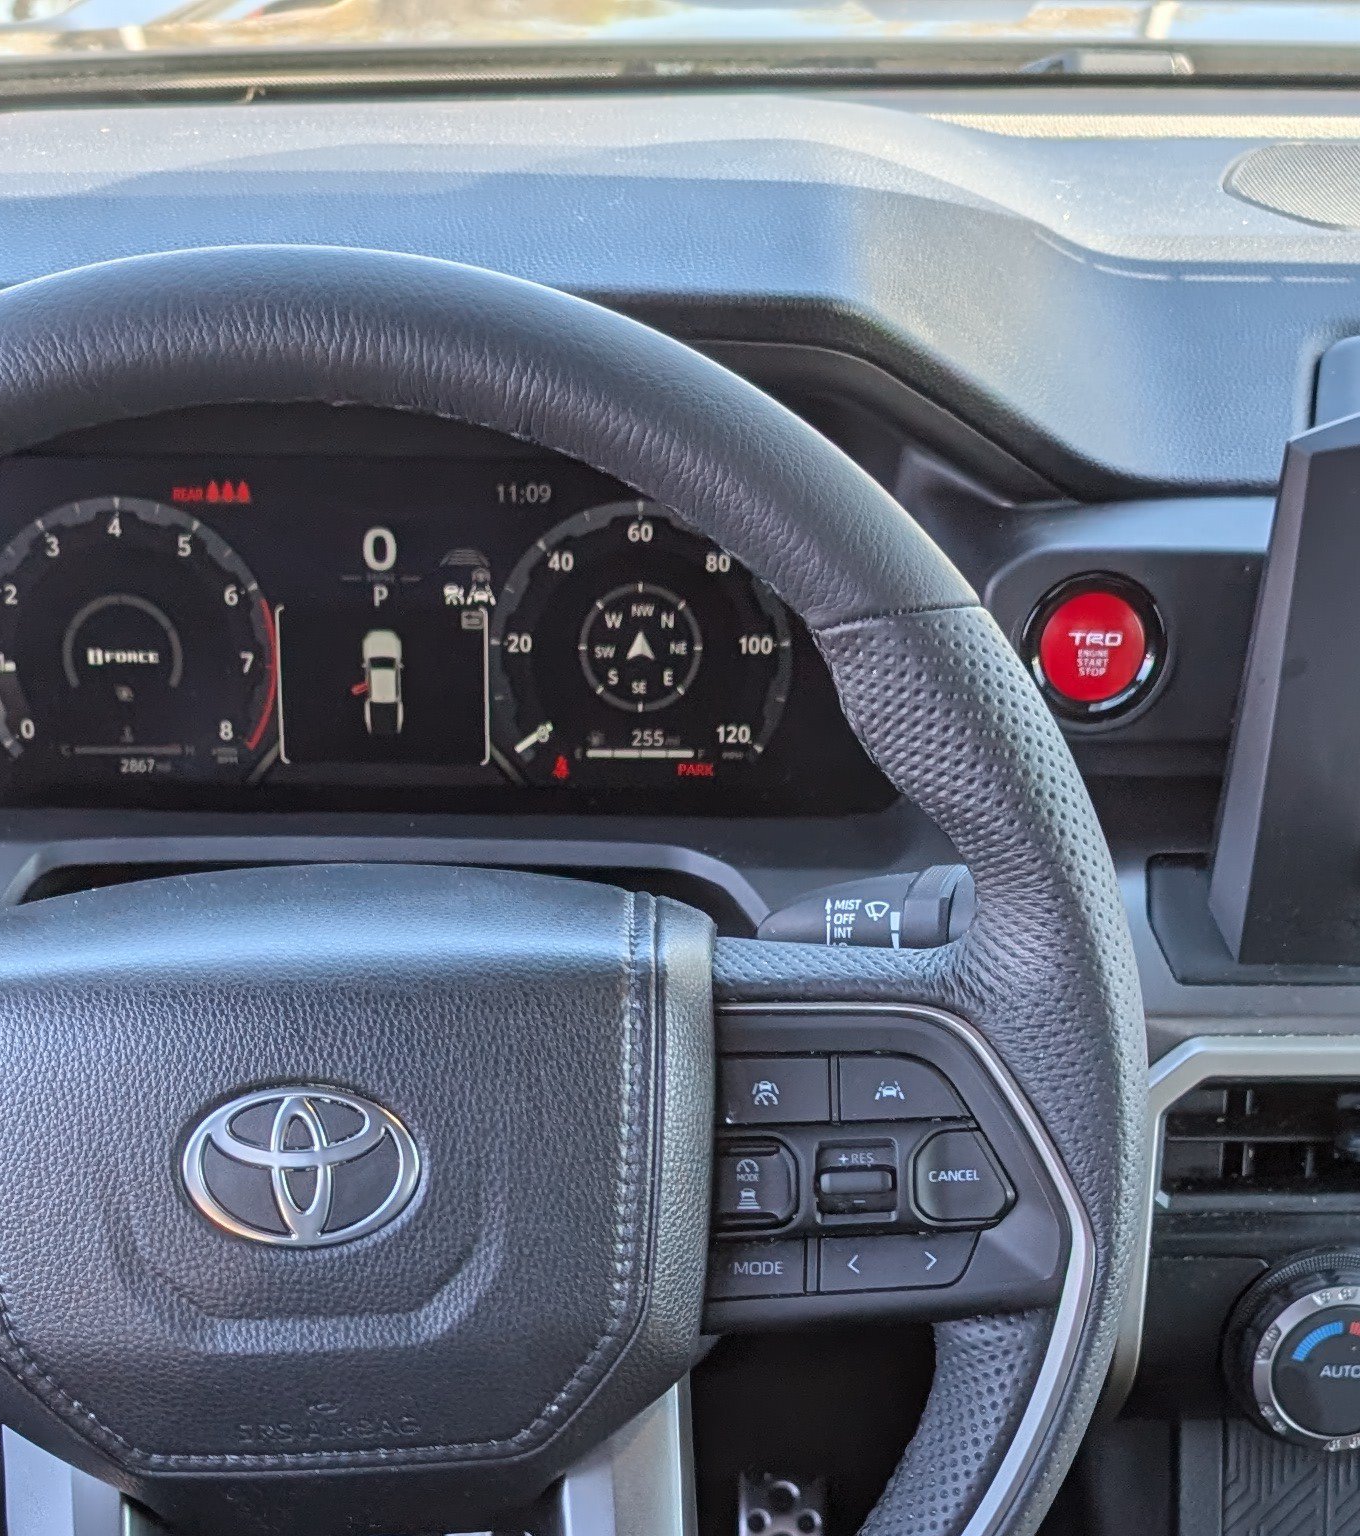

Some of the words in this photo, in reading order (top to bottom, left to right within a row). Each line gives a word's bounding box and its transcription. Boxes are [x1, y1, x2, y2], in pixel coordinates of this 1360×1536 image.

[496, 483, 551, 503] 11:09
[107, 518, 122, 537] 4
[626, 521, 654, 542] 60
[45, 536, 60, 557] 3
[177, 536, 191, 557] 5
[362, 526, 397, 571] 0
[547, 552, 574, 572] 40
[705, 553, 731, 573] 80
[2, 583, 18, 605] 2
[223, 584, 239, 606] 6
[372, 583, 389, 607] P
[604, 612, 623, 629] W
[660, 612, 675, 629] N
[507, 634, 533, 653] 20
[739, 635, 773, 655] 100
[1068, 631, 1123, 646] TRD
[240, 651, 254, 673] 7
[607, 668, 619, 685] S
[663, 669, 674, 686] E
[1078, 667, 1106, 677] STOP
[20, 718, 35, 739] 0
[219, 720, 233, 741] 8
[716, 725, 750, 744] 120
[631, 730, 664, 747] 255
[121, 758, 154, 773] 2867
[676, 763, 714, 776] PARK
[834, 900, 861, 910] MIST
[833, 913, 855, 924] OFF
[833, 927, 853, 939] INT
[928, 1170, 980, 1182] CANCEL
[734, 1261, 784, 1275] MODE
